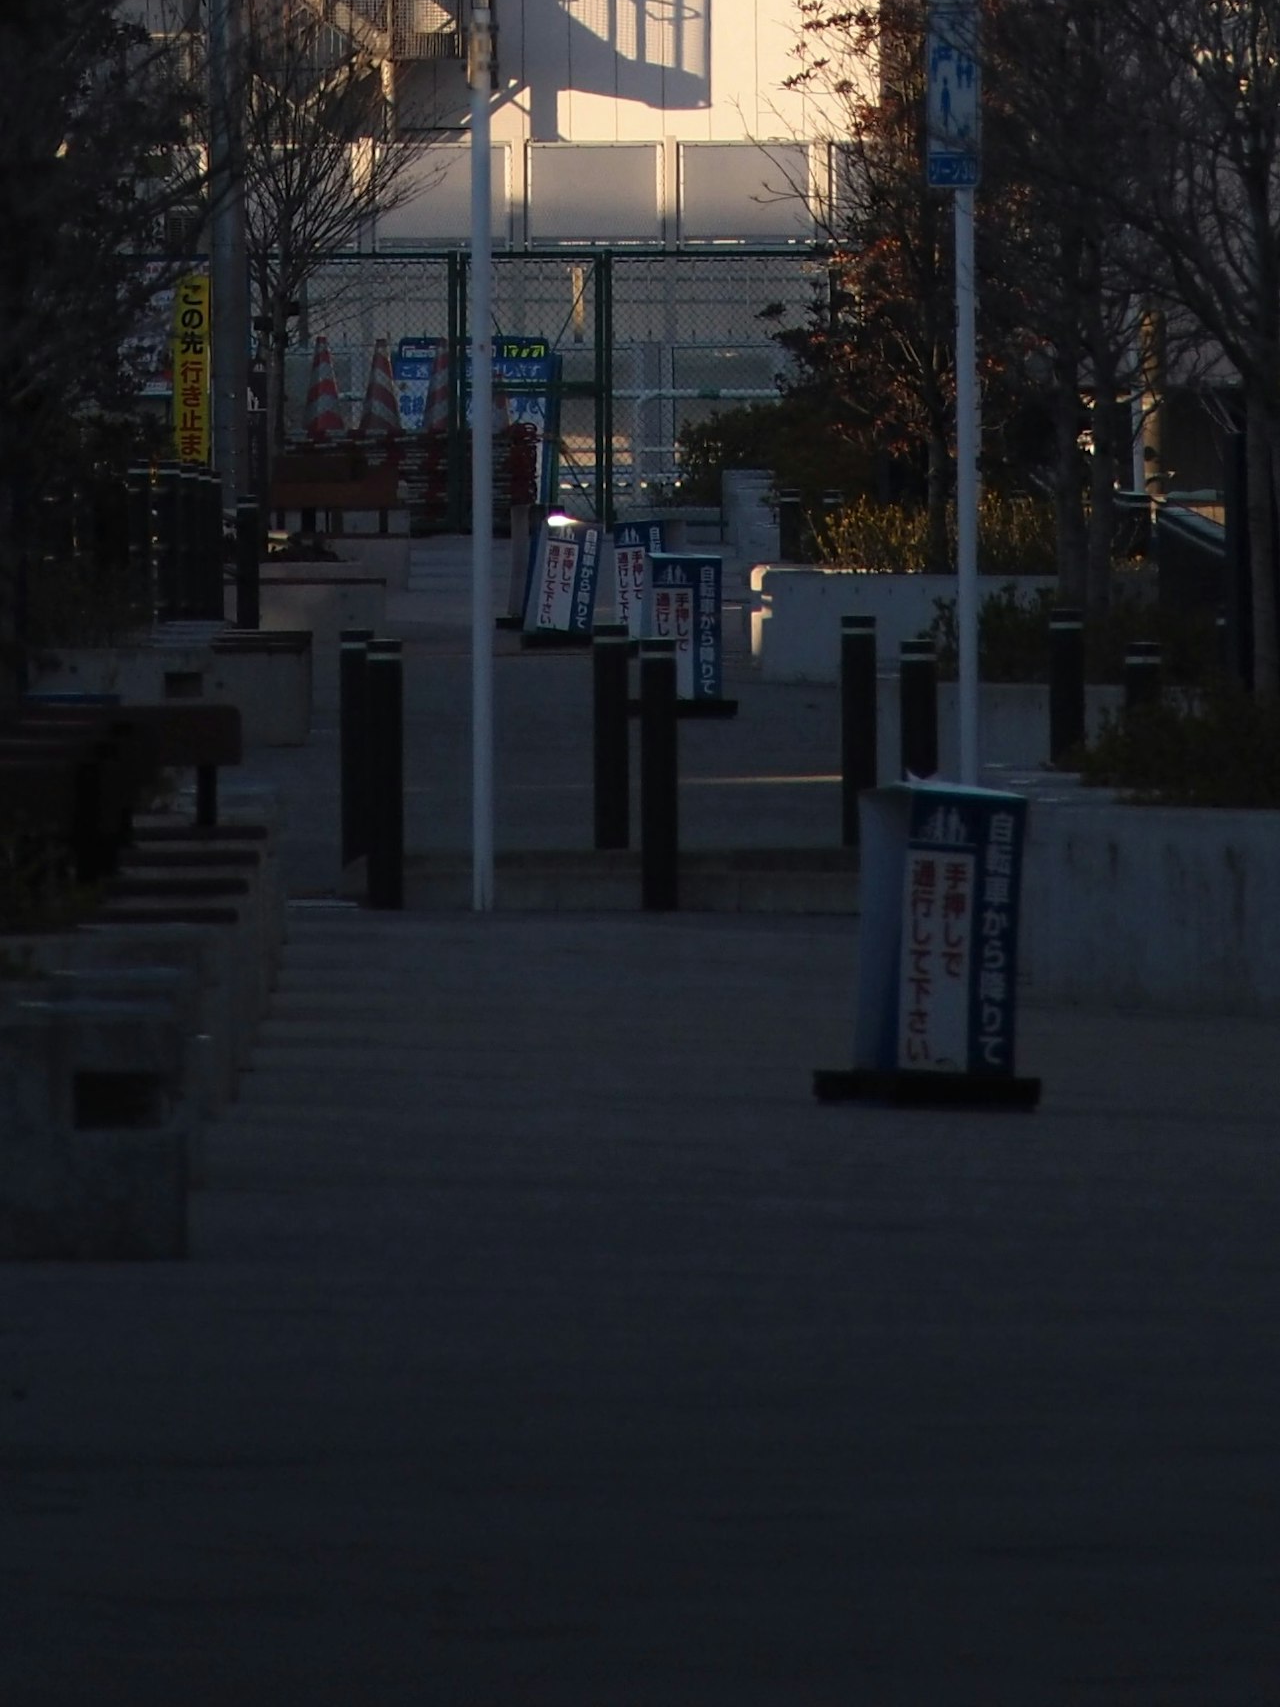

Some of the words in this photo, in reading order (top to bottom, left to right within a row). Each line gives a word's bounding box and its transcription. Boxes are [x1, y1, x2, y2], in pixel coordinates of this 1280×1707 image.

[180, 284, 204, 466] この先行き止ま
[539, 544, 561, 624] 通行して下さい
[560, 547, 575, 593] 手押して
[574, 528, 599, 629] 自転車から降りて
[631, 550, 644, 600] 手押して
[675, 592, 690, 652] 手押して
[699, 565, 716, 694] 自転車から降りて
[907, 860, 936, 1063] 通行して下さい
[941, 862, 967, 978] 手押して
[978, 811, 1016, 1065] 自転車から降りて
